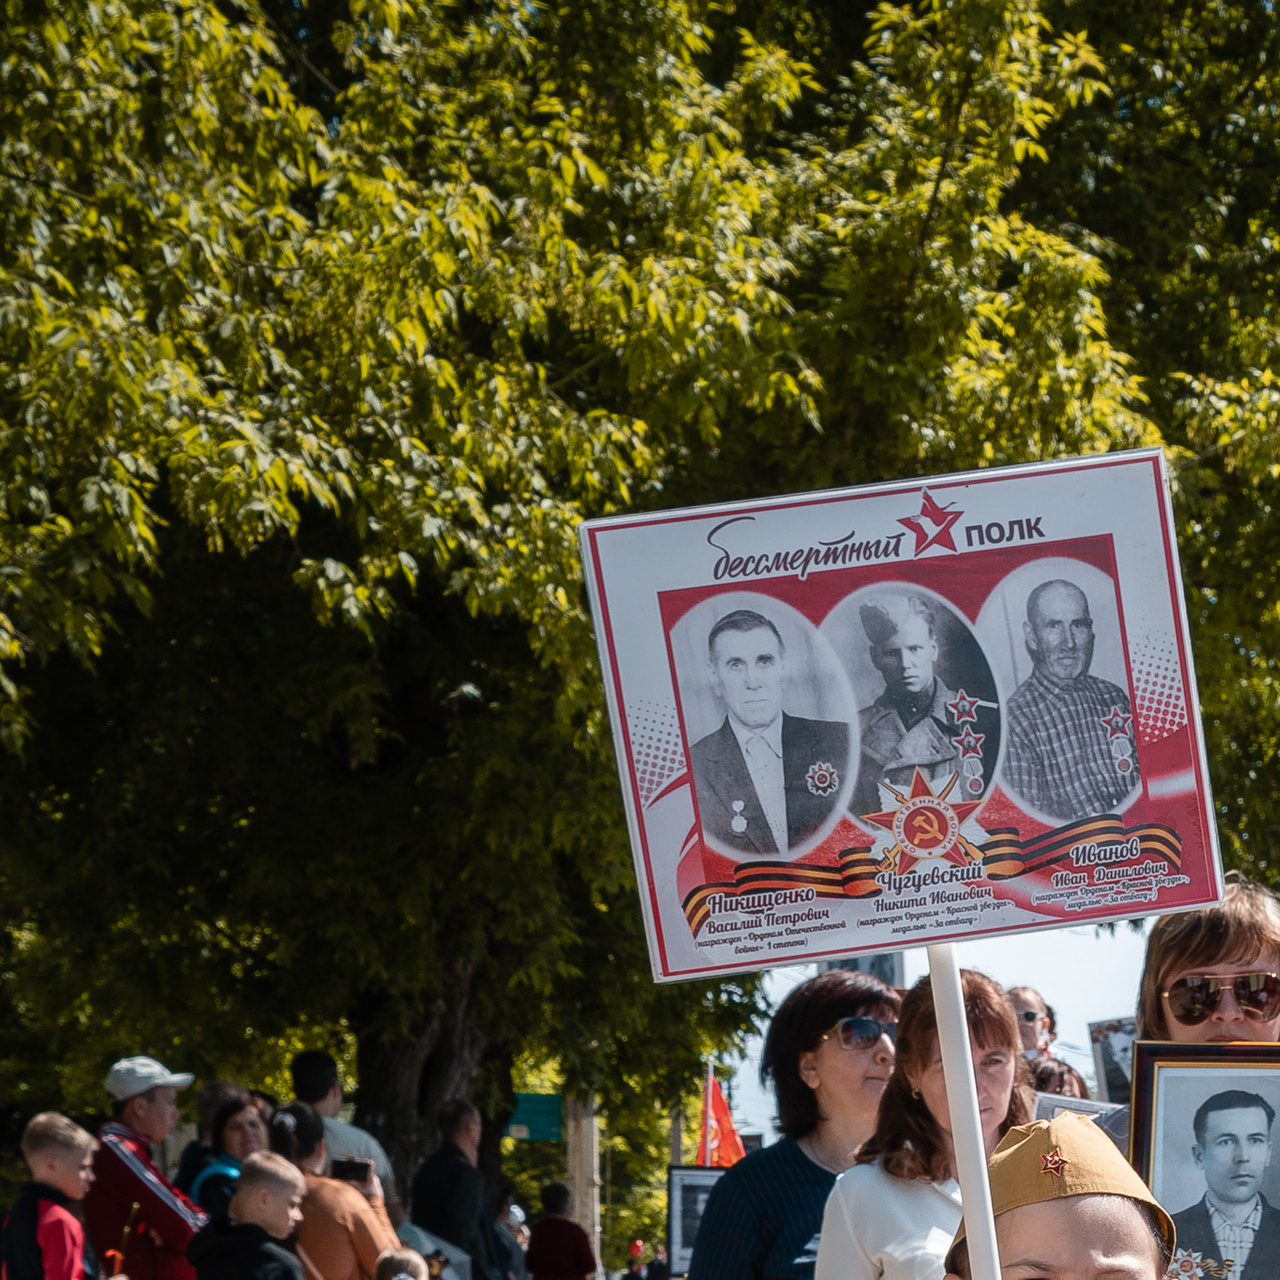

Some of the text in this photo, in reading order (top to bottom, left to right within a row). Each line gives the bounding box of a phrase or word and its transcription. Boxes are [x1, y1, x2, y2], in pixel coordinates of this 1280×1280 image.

[707, 516, 1045, 580] бессмертный ПОЛК
[1072, 838, 1139, 865] Иванов
[876, 862, 983, 895] Чугуевский
[1052, 861, 1167, 888] Иван Данилович
[708, 888, 815, 914] Никищенко
[874, 888, 992, 912] Никита Иванович
[706, 907, 829, 934] Василий Петрович
